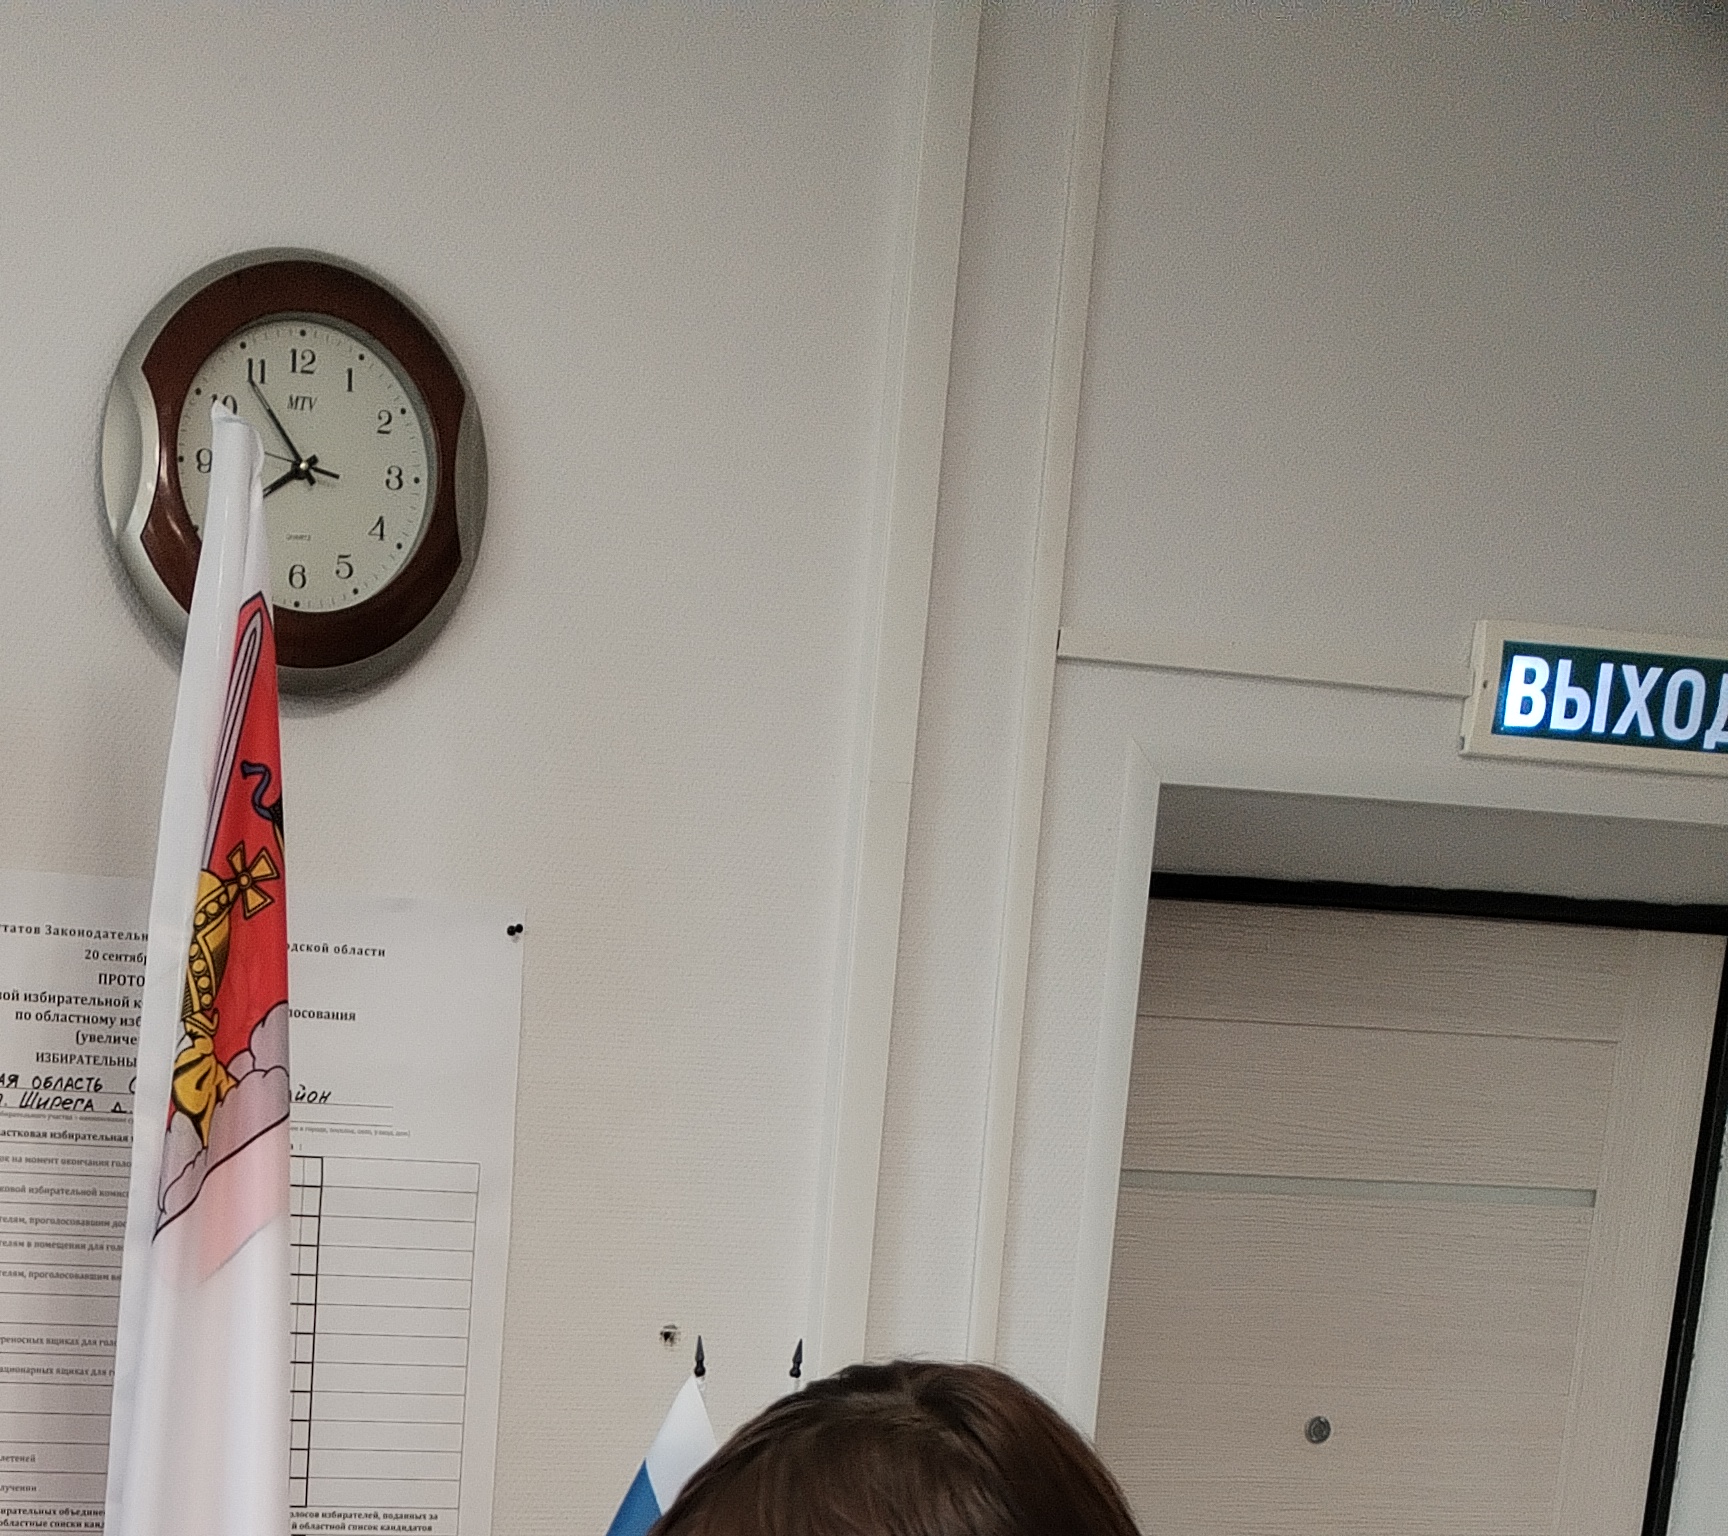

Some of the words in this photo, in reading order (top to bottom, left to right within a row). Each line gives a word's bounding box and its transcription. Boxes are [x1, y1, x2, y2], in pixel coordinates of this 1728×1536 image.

[290, 348, 316, 374] 12
[247, 358, 267, 384] 11
[346, 367, 353, 392] 1
[377, 410, 393, 434] 2
[196, 448, 212, 473] 9
[385, 466, 404, 490] 3
[368, 515, 386, 541] 4
[335, 554, 354, 579] 5
[289, 564, 307, 589] 6
[45, 925, 148, 941] Законодательн
[85, 949, 99, 960] 20
[102, 952, 145, 966] сентяб
[334, 944, 386, 958] области
[98, 973, 145, 987] ПРОТО
[24, 991, 129, 1008] избирательной
[15, 1011, 31, 1020] по
[35, 1010, 116, 1029] областному
[289, 1008, 356, 1022] осования
[75, 1030, 137, 1045] (увеличе
[36, 1052, 137, 1067] ИЗБИРАТЕЛЬНЫ
[50, 1130, 130, 1143] избирательная
